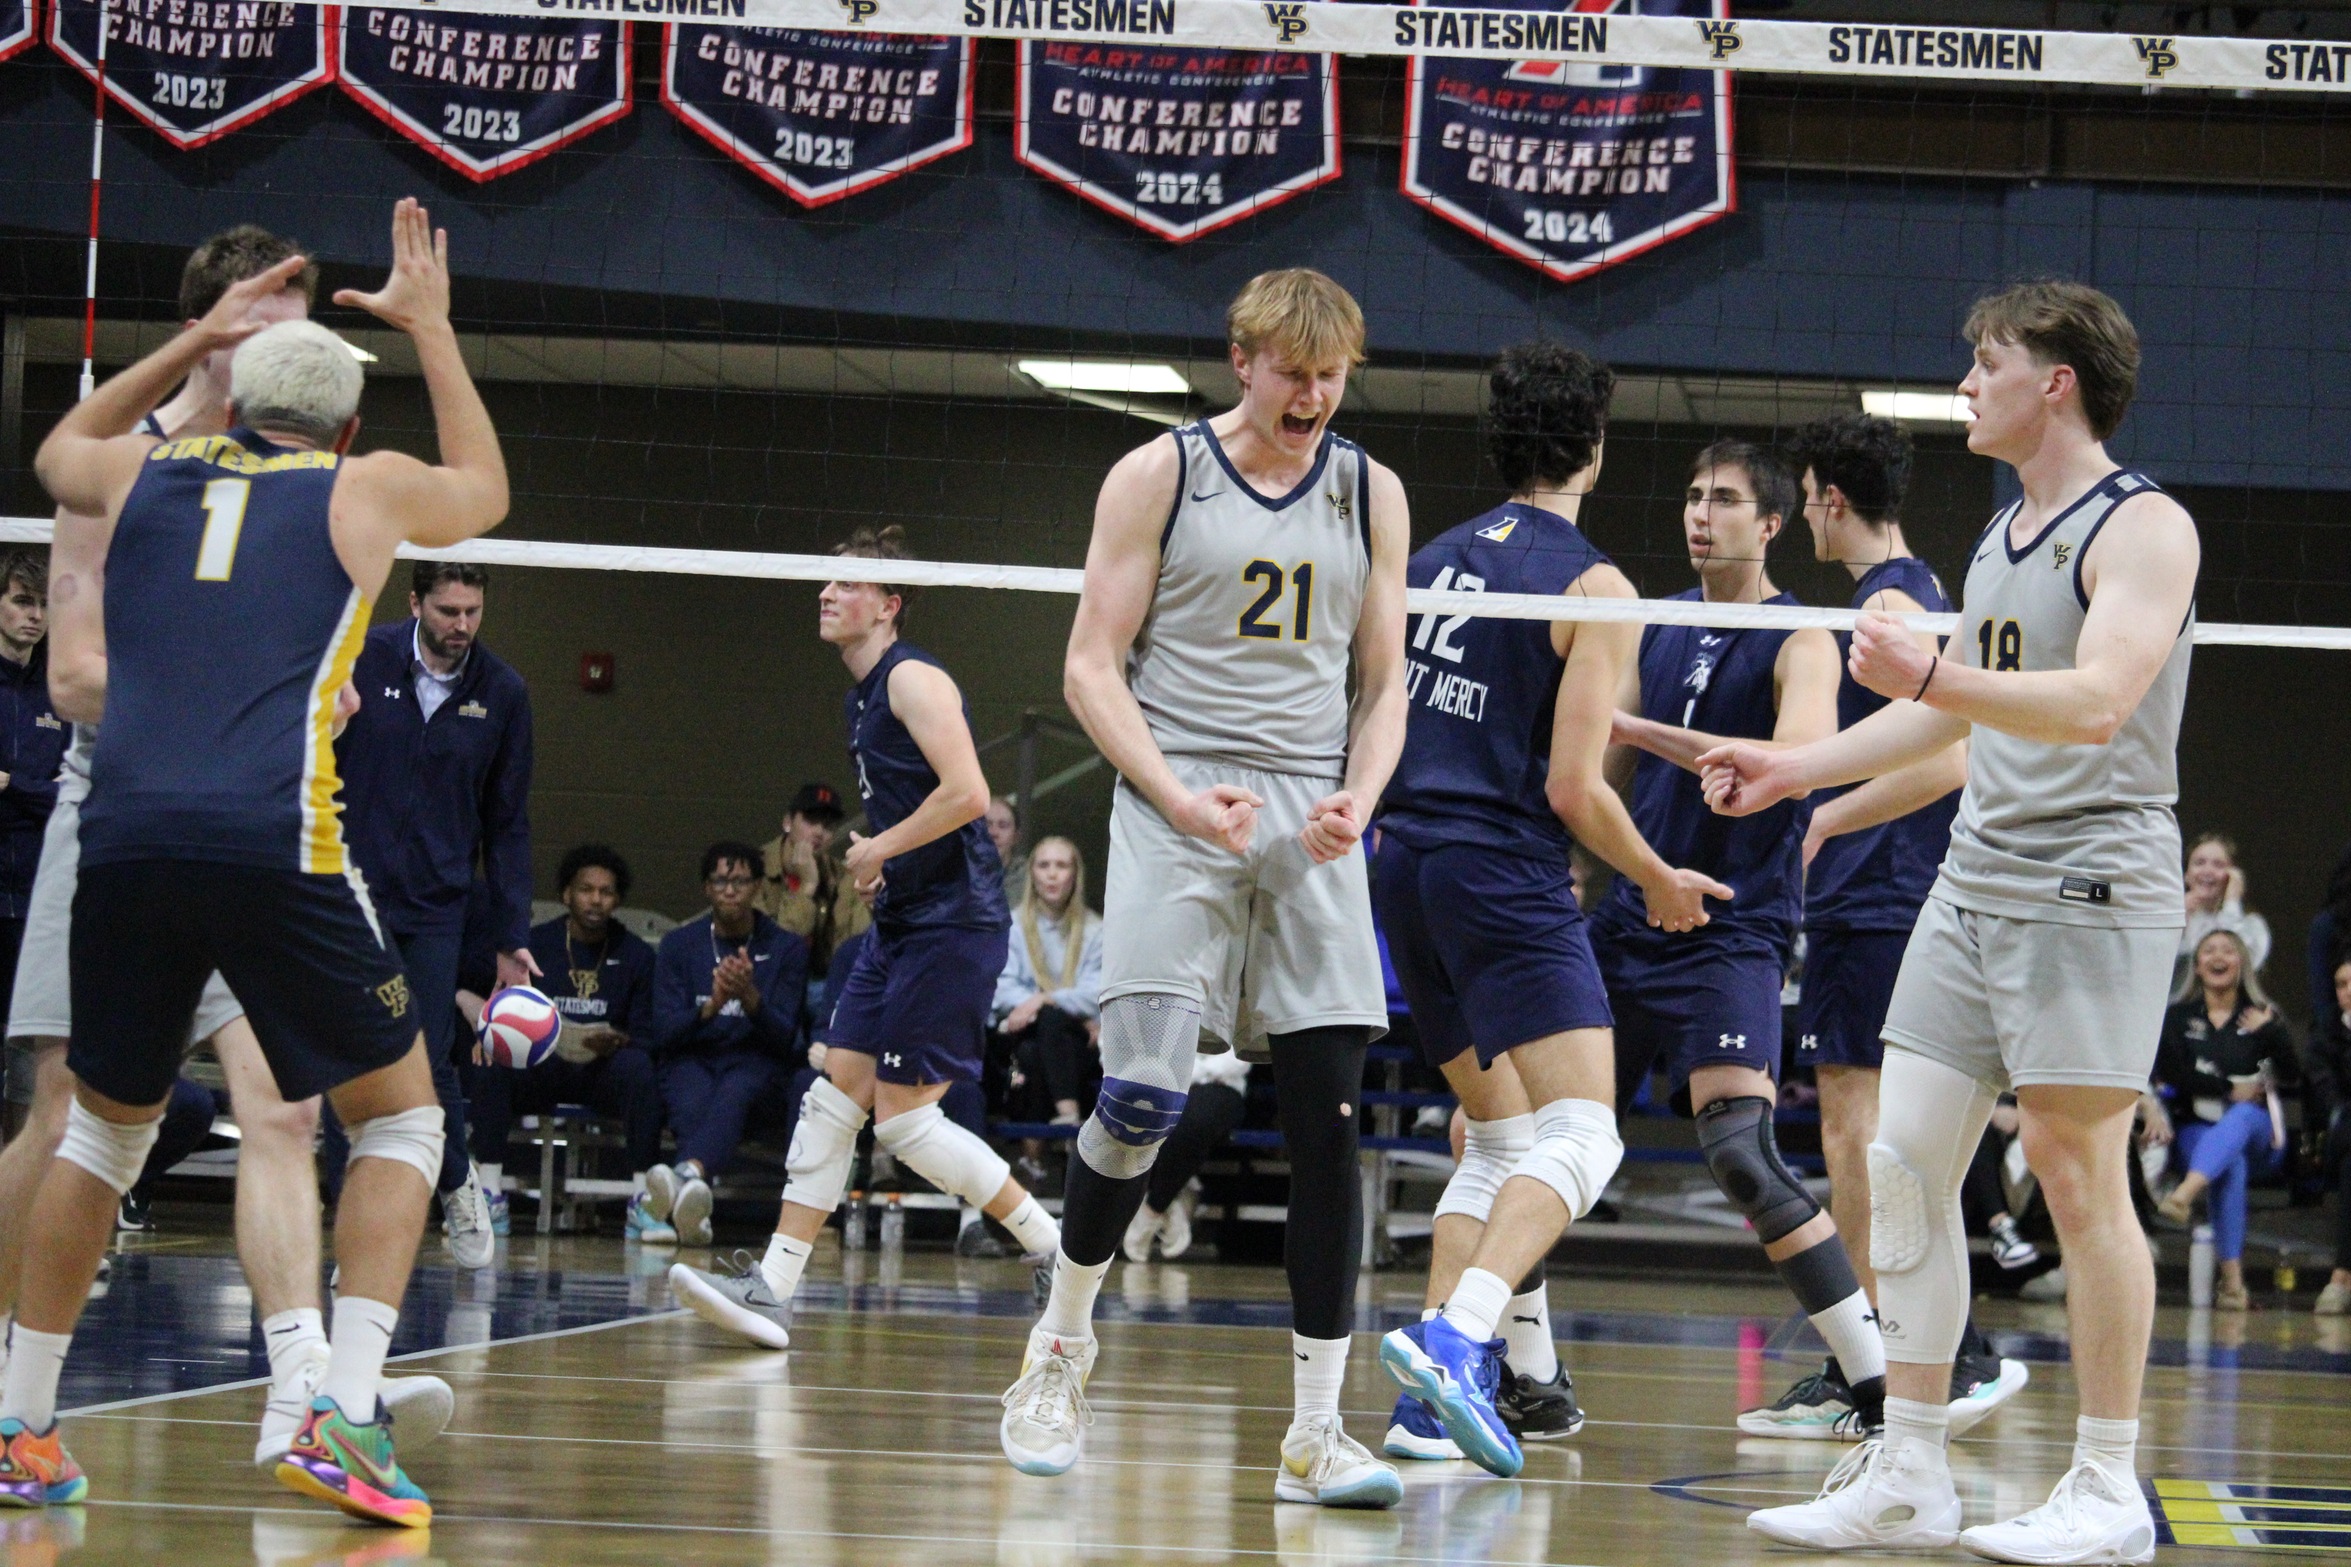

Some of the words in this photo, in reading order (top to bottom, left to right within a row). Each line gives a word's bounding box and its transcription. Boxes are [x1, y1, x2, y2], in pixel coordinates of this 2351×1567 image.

[81, 0, 295, 28] NFERENCE
[964, 0, 1175, 35] STATESMEN
[1395, 10, 1607, 53] STATESMEN
[106, 14, 275, 58] CHAMPION
[368, 10, 601, 62] CONFERENCE
[1044, 42, 1143, 68] HEART
[1183, 53, 1309, 73] AMERICA
[1829, 27, 2043, 71] STATESMEN
[390, 45, 578, 91] CHAMPION
[698, 33, 940, 96] CONFERENCE
[153, 72, 227, 110] 2023
[722, 70, 913, 124] CHAMPION
[1052, 87, 1303, 128] CONFERENCE
[443, 103, 520, 142] 2023
[1079, 121, 1280, 156] CHAMPION
[774, 127, 854, 169] 2023
[1441, 121, 1695, 168] CONFERENCE
[1136, 170, 1223, 205] 2024
[1467, 155, 1672, 195] CHAMPION
[1523, 209, 1615, 243] 2024
[150, 435, 338, 475] STATESMEN
[195, 477, 250, 581] 1
[1238, 557, 1314, 643] 21
[1412, 565, 1487, 664] 12
[1977, 616, 2021, 672] 18
[1425, 670, 1488, 722] MERCY
